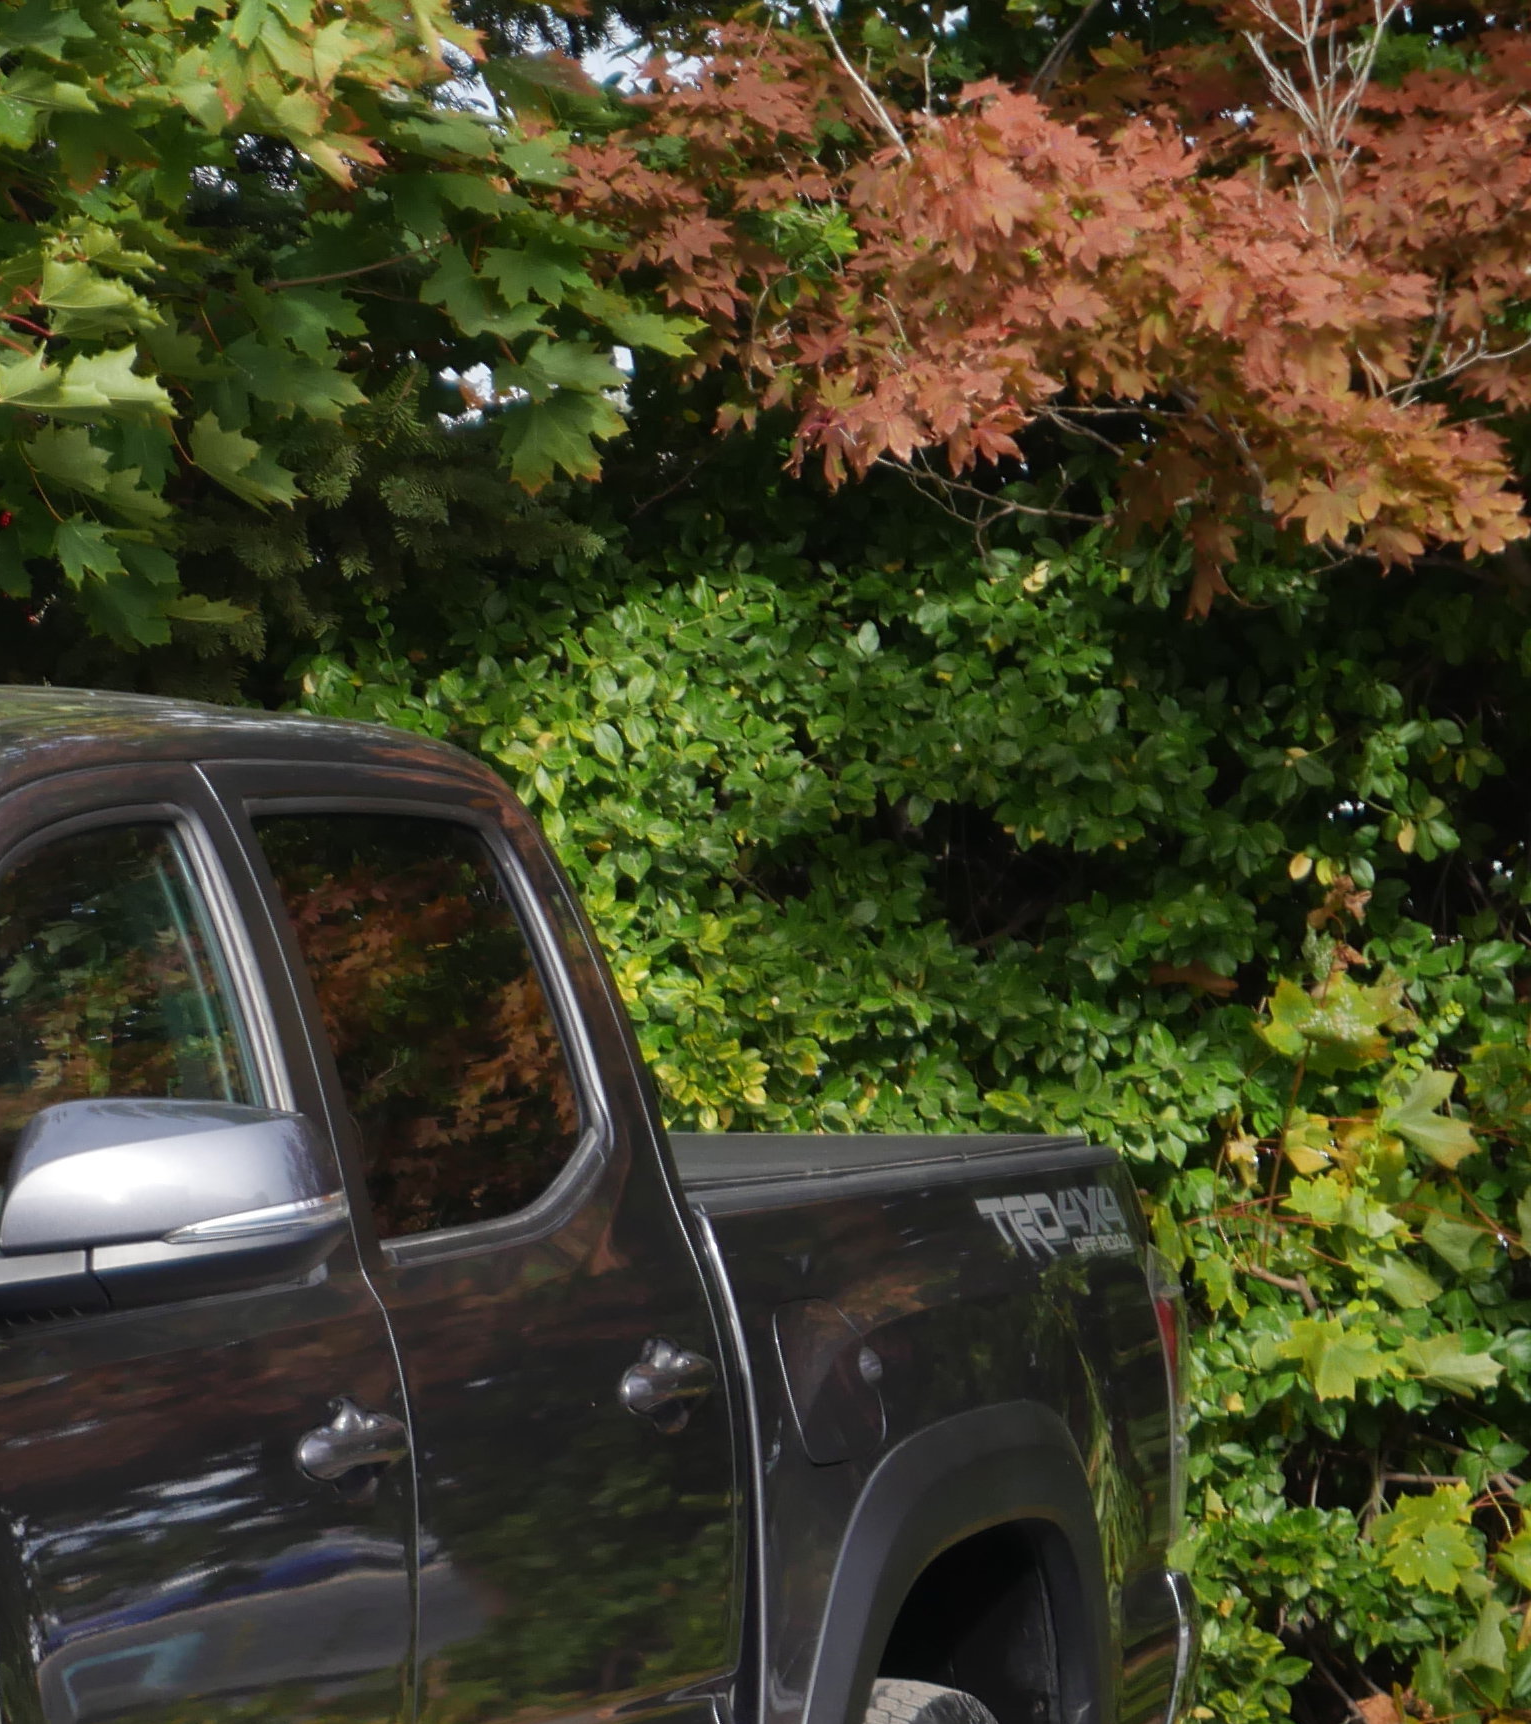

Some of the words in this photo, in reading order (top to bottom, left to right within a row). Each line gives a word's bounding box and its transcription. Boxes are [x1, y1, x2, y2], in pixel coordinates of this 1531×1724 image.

[975, 1193, 1069, 1259] TRD
[1057, 1185, 1128, 1235] 4X4
[1072, 1235, 1097, 1254] OFF
[1098, 1232, 1134, 1253] ROAD
